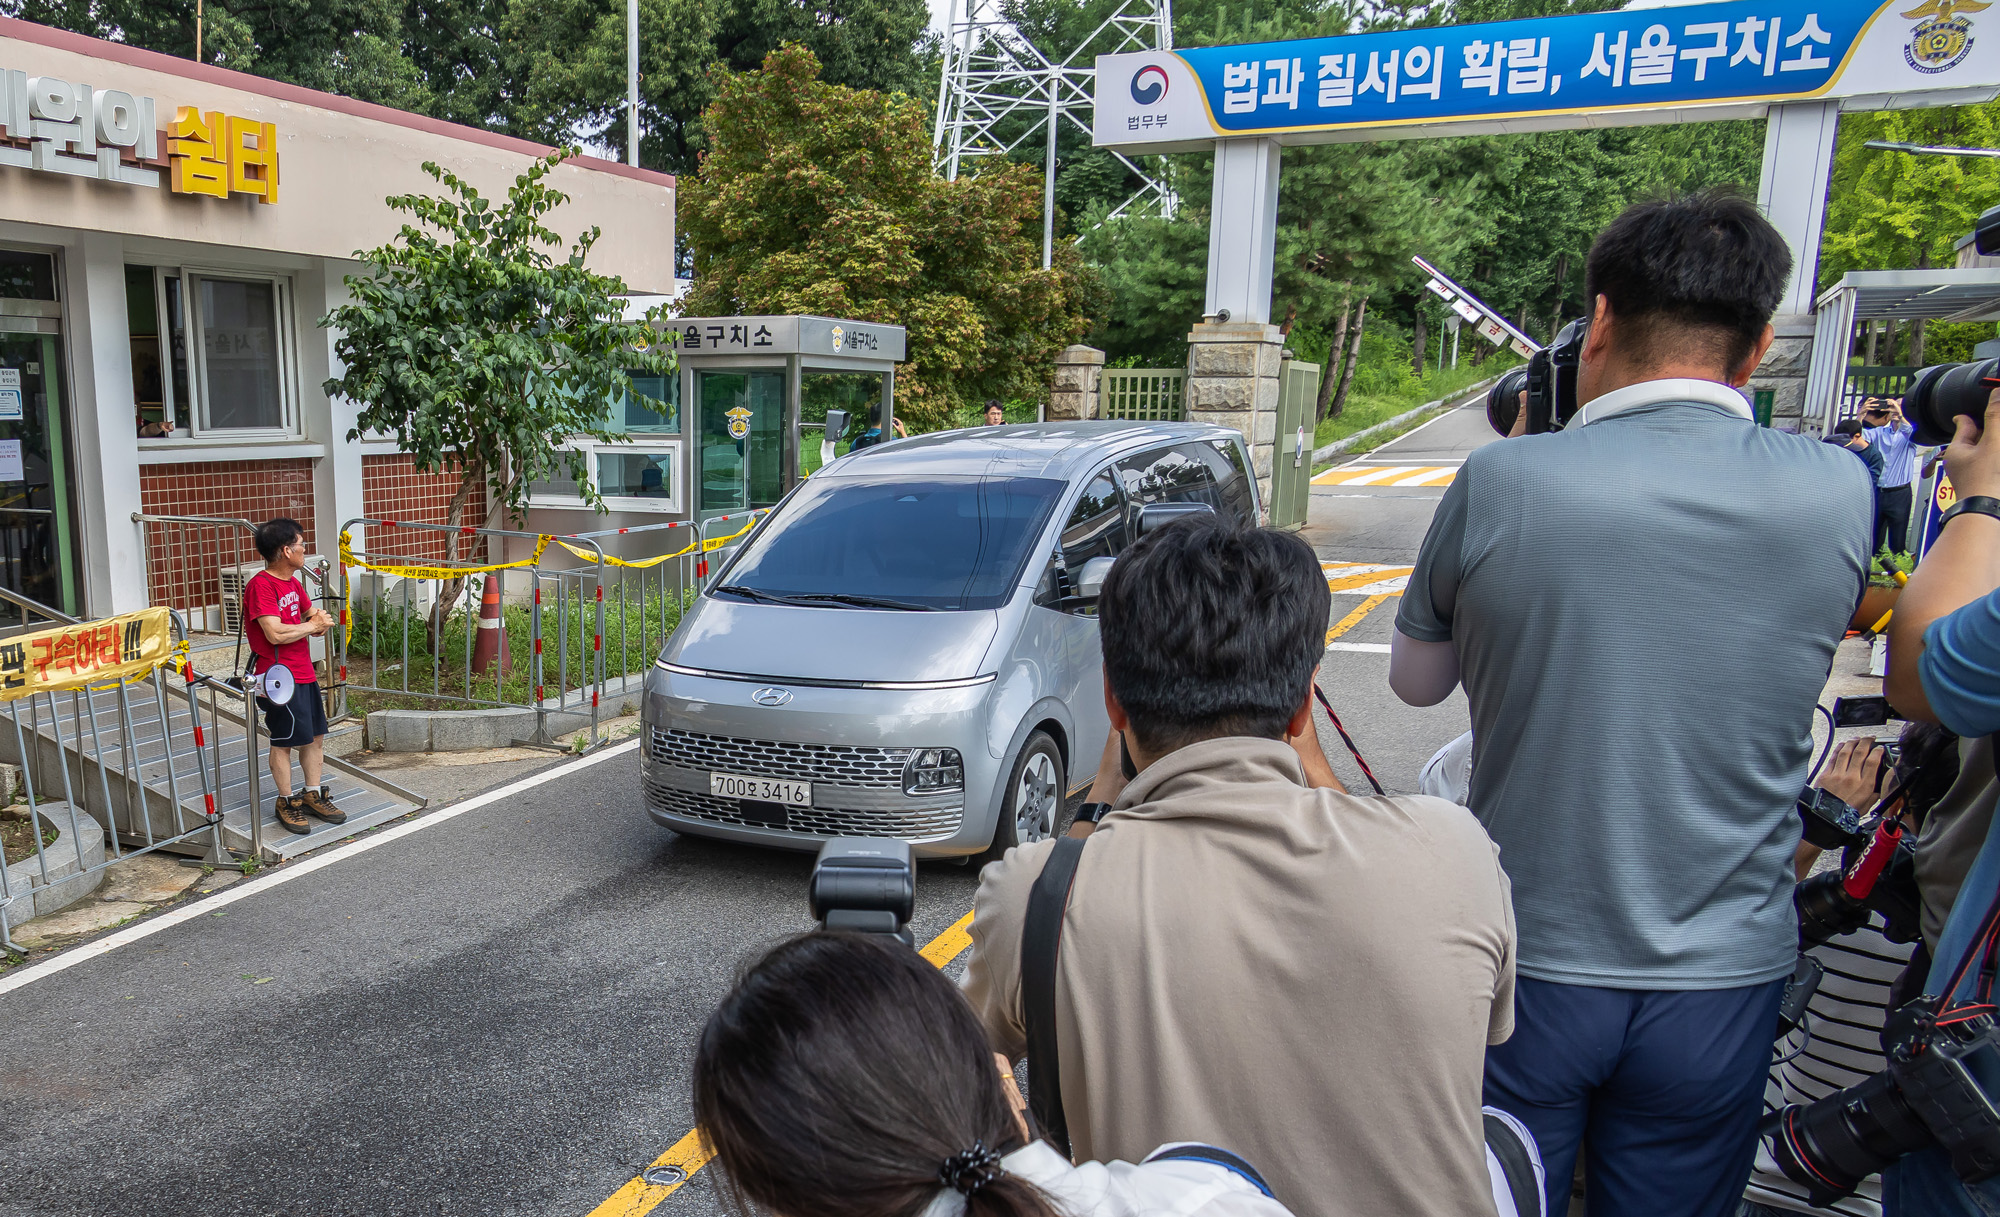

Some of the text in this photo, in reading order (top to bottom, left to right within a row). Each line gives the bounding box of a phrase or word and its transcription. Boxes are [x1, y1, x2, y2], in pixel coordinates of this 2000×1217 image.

[1223, 13, 1832, 114] 법과 질서의 확립, 서울구치소
[1128, 114, 1168, 130] 법무부
[167, 106, 278, 205] 쉼터
[844, 330, 878, 350] 서울구치소
[762, 781, 804, 802] 3416
